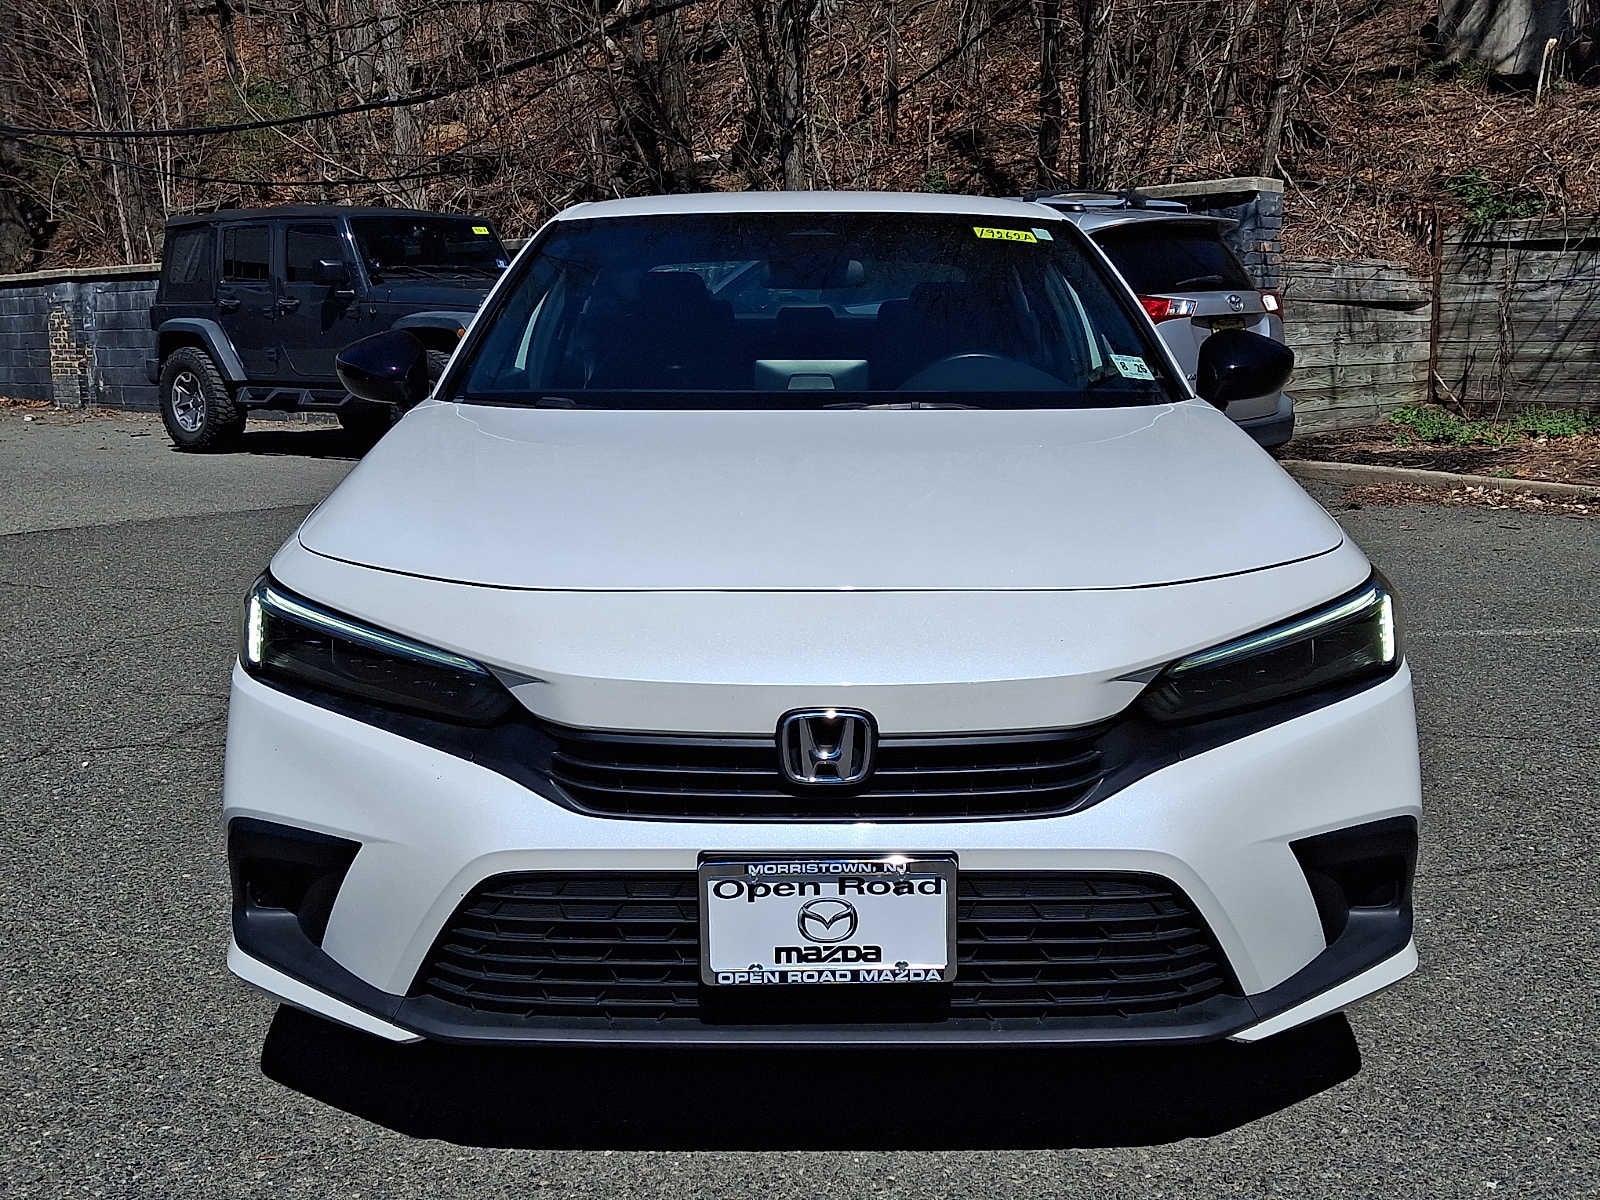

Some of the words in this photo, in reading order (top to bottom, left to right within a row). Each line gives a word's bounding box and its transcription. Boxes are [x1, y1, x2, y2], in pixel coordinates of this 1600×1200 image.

[1120, 361, 1129, 371] 8
[748, 863, 877, 875] MORRISTOWN,
[883, 863, 907, 874] NJ
[712, 878, 821, 903] Open
[838, 876, 942, 896] Road
[717, 971, 780, 985] OPEN
[787, 970, 852, 983] ROAD
[859, 968, 942, 982] MAZDA
